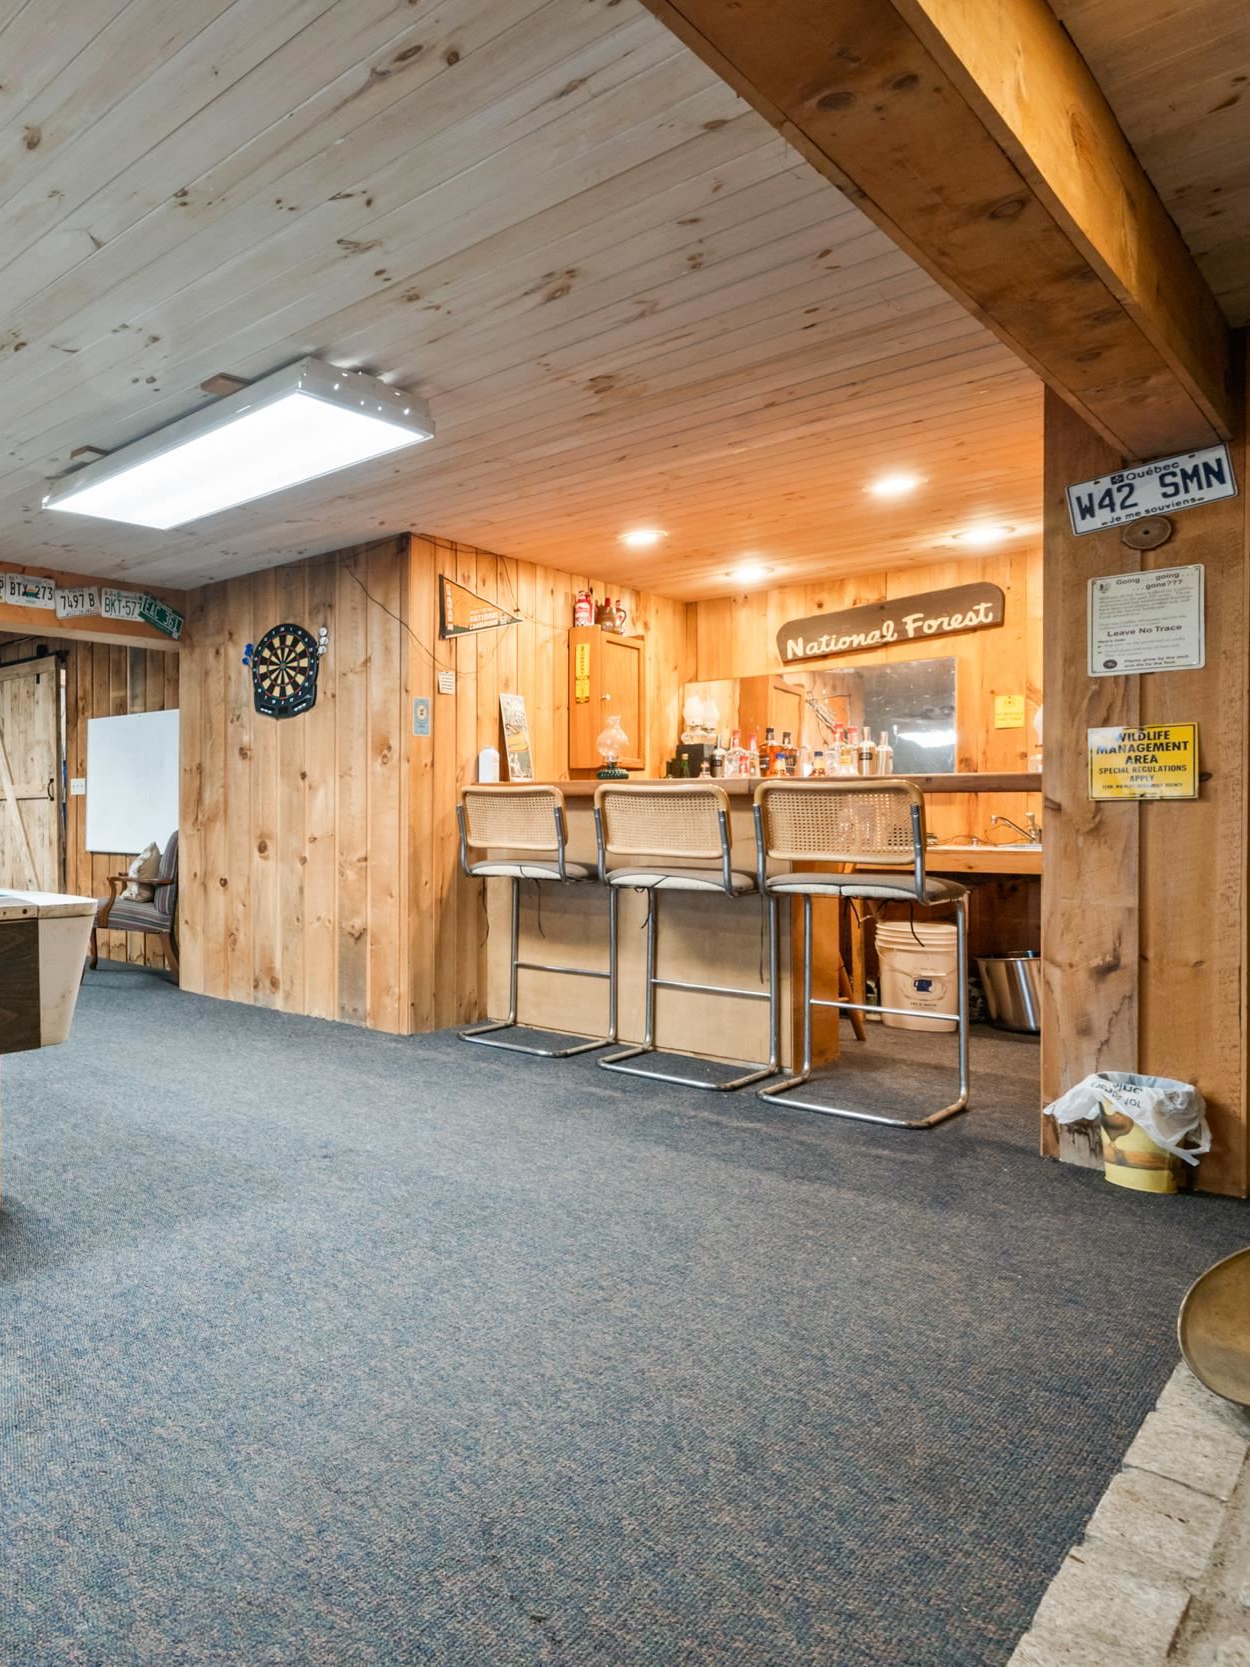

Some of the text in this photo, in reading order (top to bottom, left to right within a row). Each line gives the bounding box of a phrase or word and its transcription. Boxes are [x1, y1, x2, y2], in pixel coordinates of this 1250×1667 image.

[1126, 461, 1181, 482] Québec
[1075, 457, 1227, 521] W42 SMN
[1110, 497, 1197, 524] Je me souviens
[1116, 577, 1141, 586] Going
[1155, 572, 1180, 581] going
[10, 581, 29, 597] BTX
[35, 585, 53, 601] 273
[60, 593, 85, 611] 7497
[88, 593, 95, 608] B
[786, 602, 994, 660] National Forest
[1107, 629, 1136, 637] Leave
[1155, 624, 1183, 632] Trace
[1117, 730, 1171, 742] WILDLIFE
[1096, 740, 1189, 755] MANAGEMENT
[1125, 754, 1159, 765] AREA
[1099, 764, 1187, 775] SPECIAL REGULATIONS
[1129, 774, 1155, 782] APPLY
